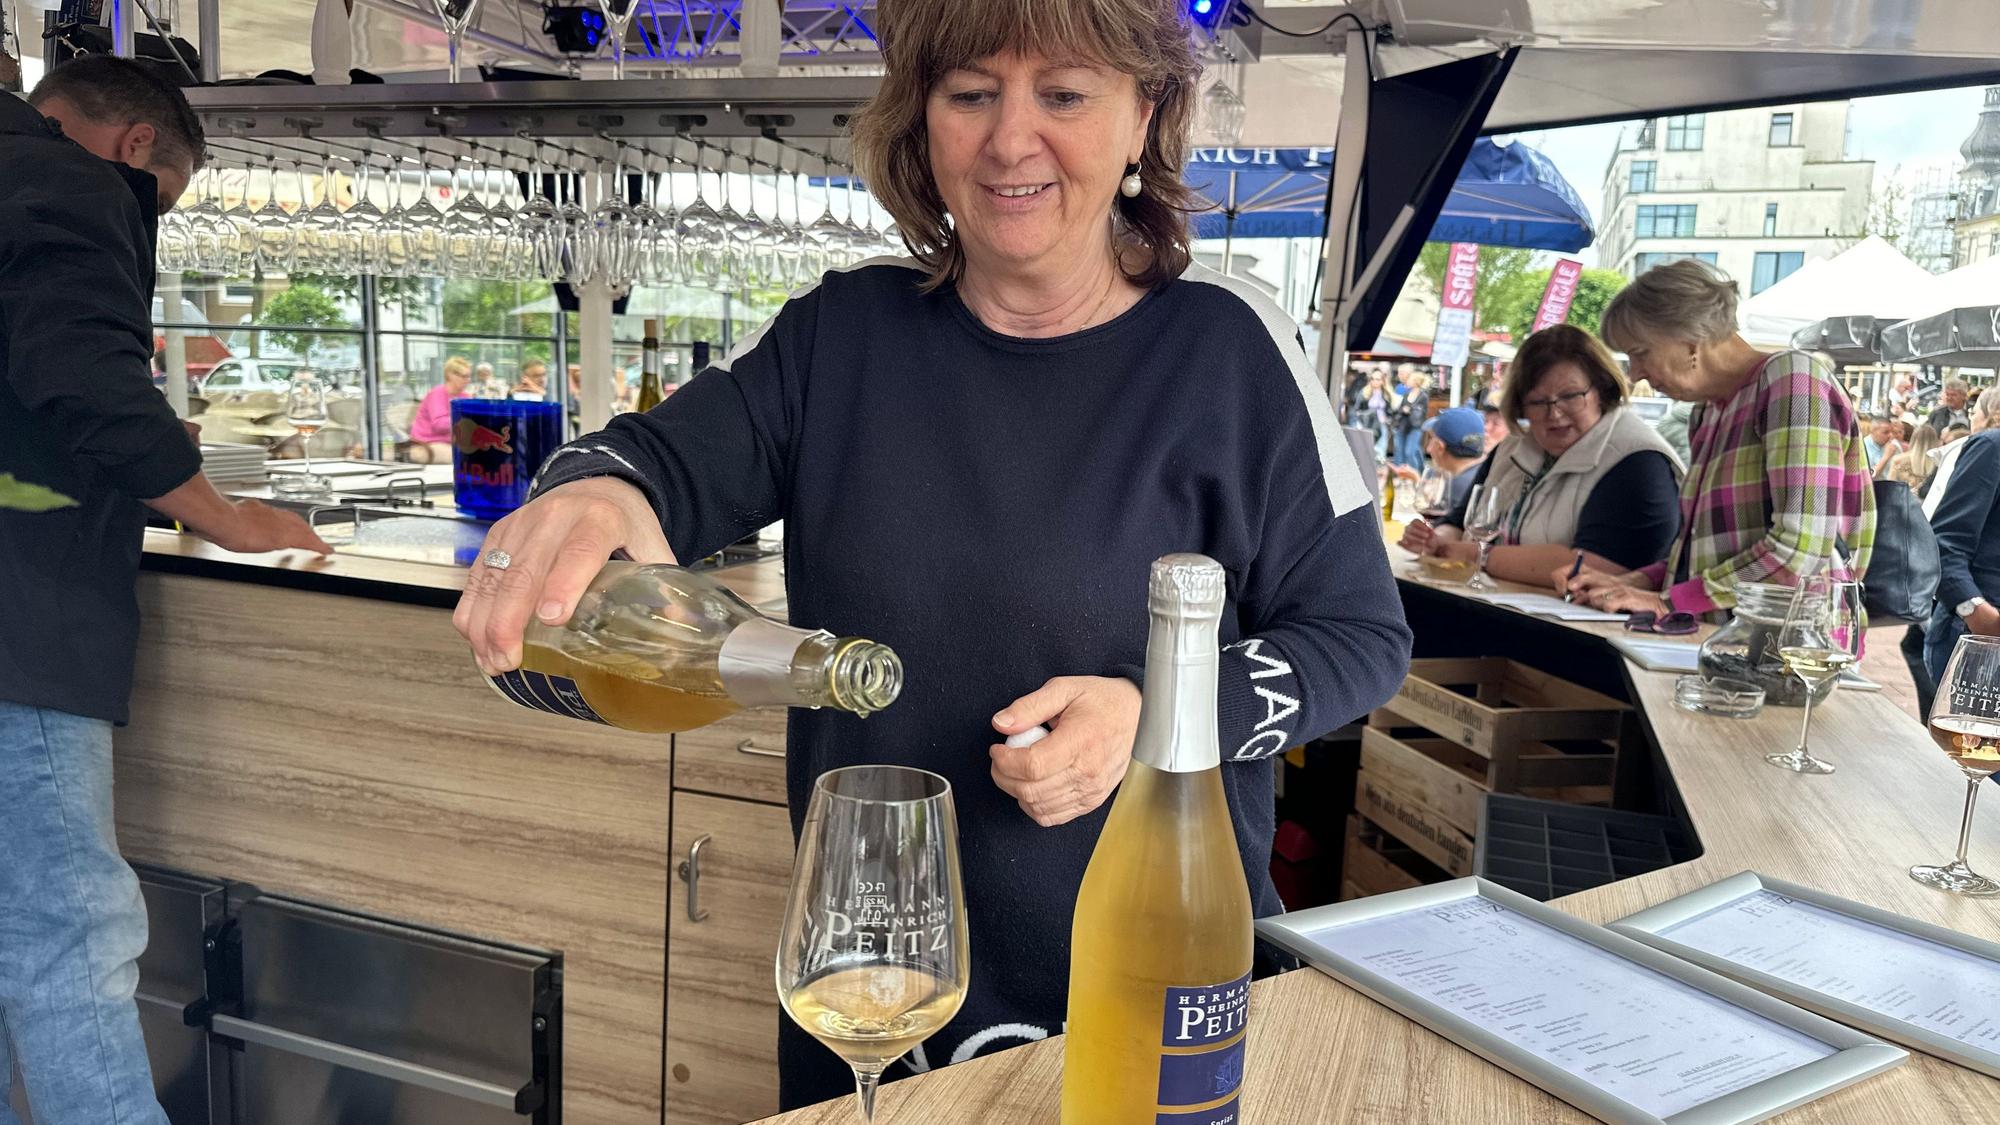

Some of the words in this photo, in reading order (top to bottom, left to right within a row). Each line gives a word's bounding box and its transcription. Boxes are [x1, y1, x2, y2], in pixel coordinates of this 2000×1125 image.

[1190, 147, 1279, 165] RICH
[1450, 243, 1478, 306] SPÄTZ
[1957, 686, 2000, 699] HEINRIC
[1432, 904, 1504, 923] PEITZ
[820, 909, 948, 961] PEITZ
[1178, 979, 1250, 1005] HERMAN
[1207, 991, 1249, 1014] HEINRI
[1175, 1003, 1249, 1040] PEIT
